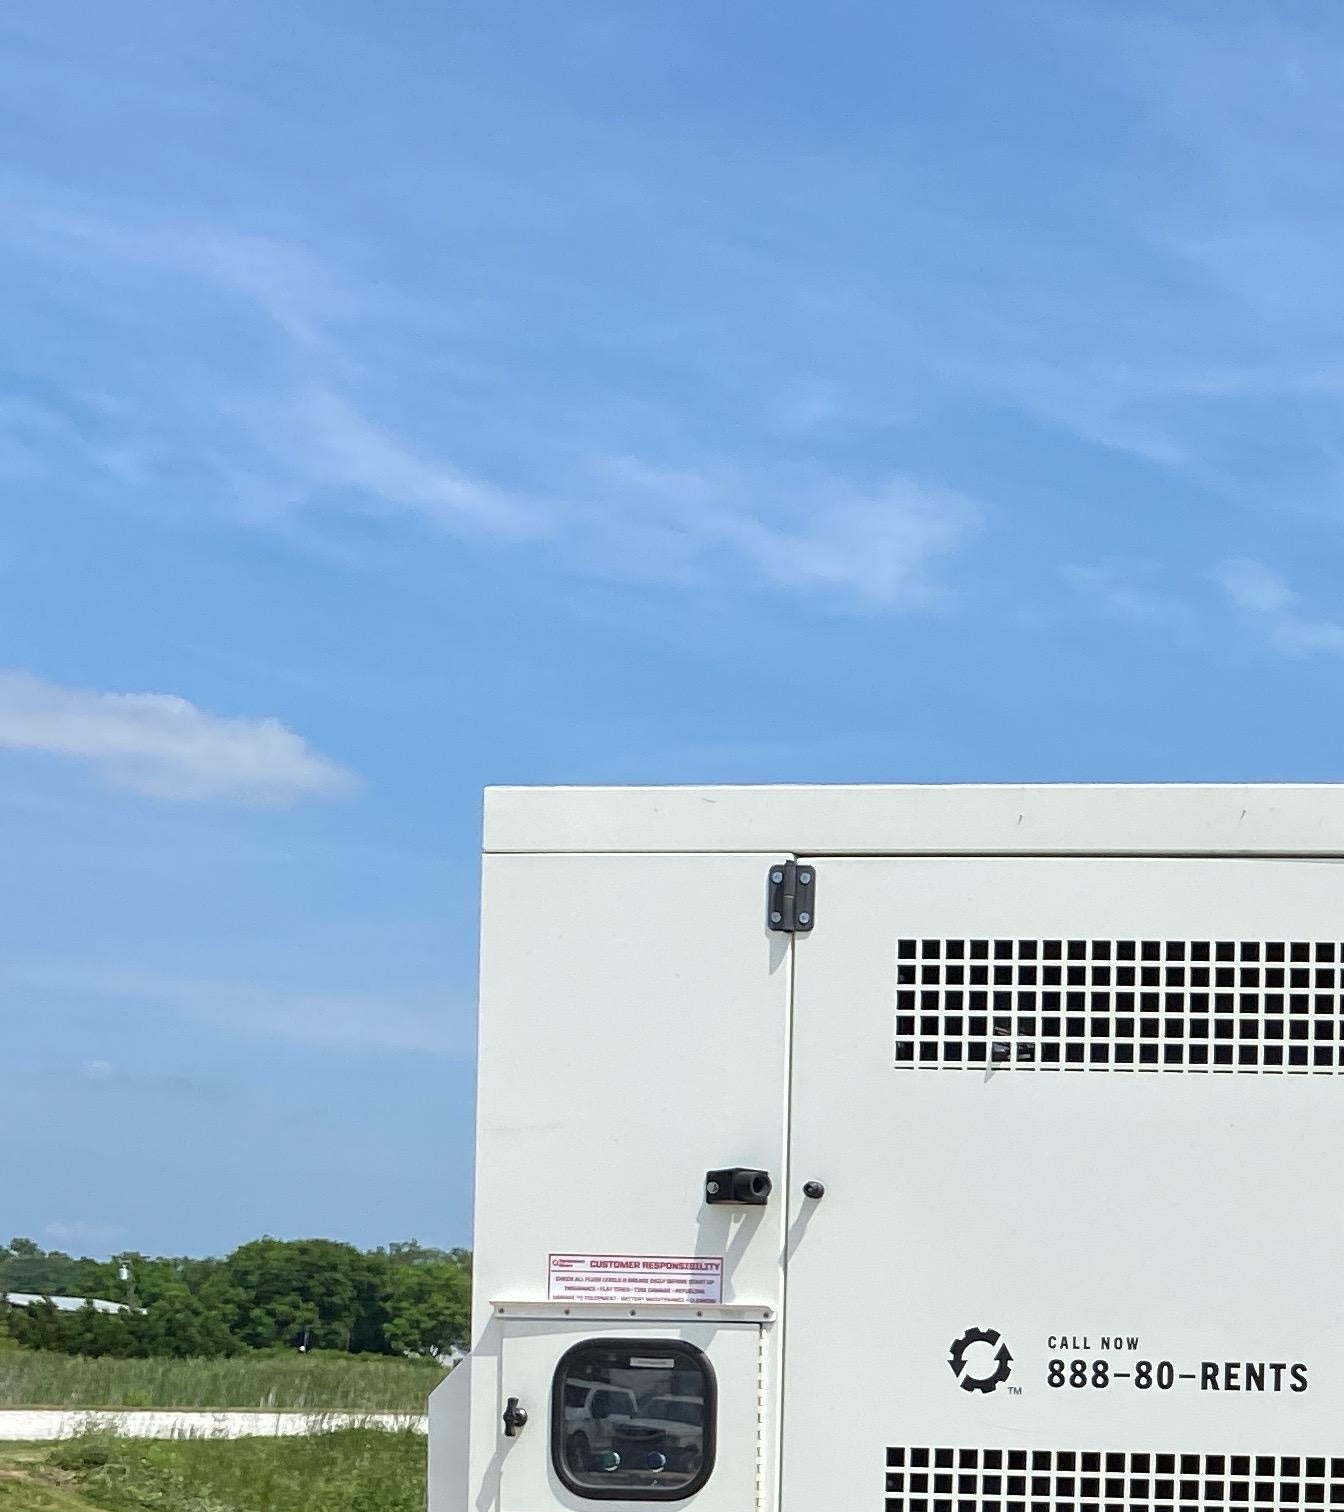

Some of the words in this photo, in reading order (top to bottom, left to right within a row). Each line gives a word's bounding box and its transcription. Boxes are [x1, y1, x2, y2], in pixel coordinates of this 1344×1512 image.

[590, 1260, 641, 1269] CUSTOMER
[643, 1262, 720, 1271] RESPONSIBILITY
[1047, 1336, 1091, 1350] CALL
[1100, 1337, 1139, 1351] NOW
[1047, 1359, 1308, 1393] 888-80-RENTS
